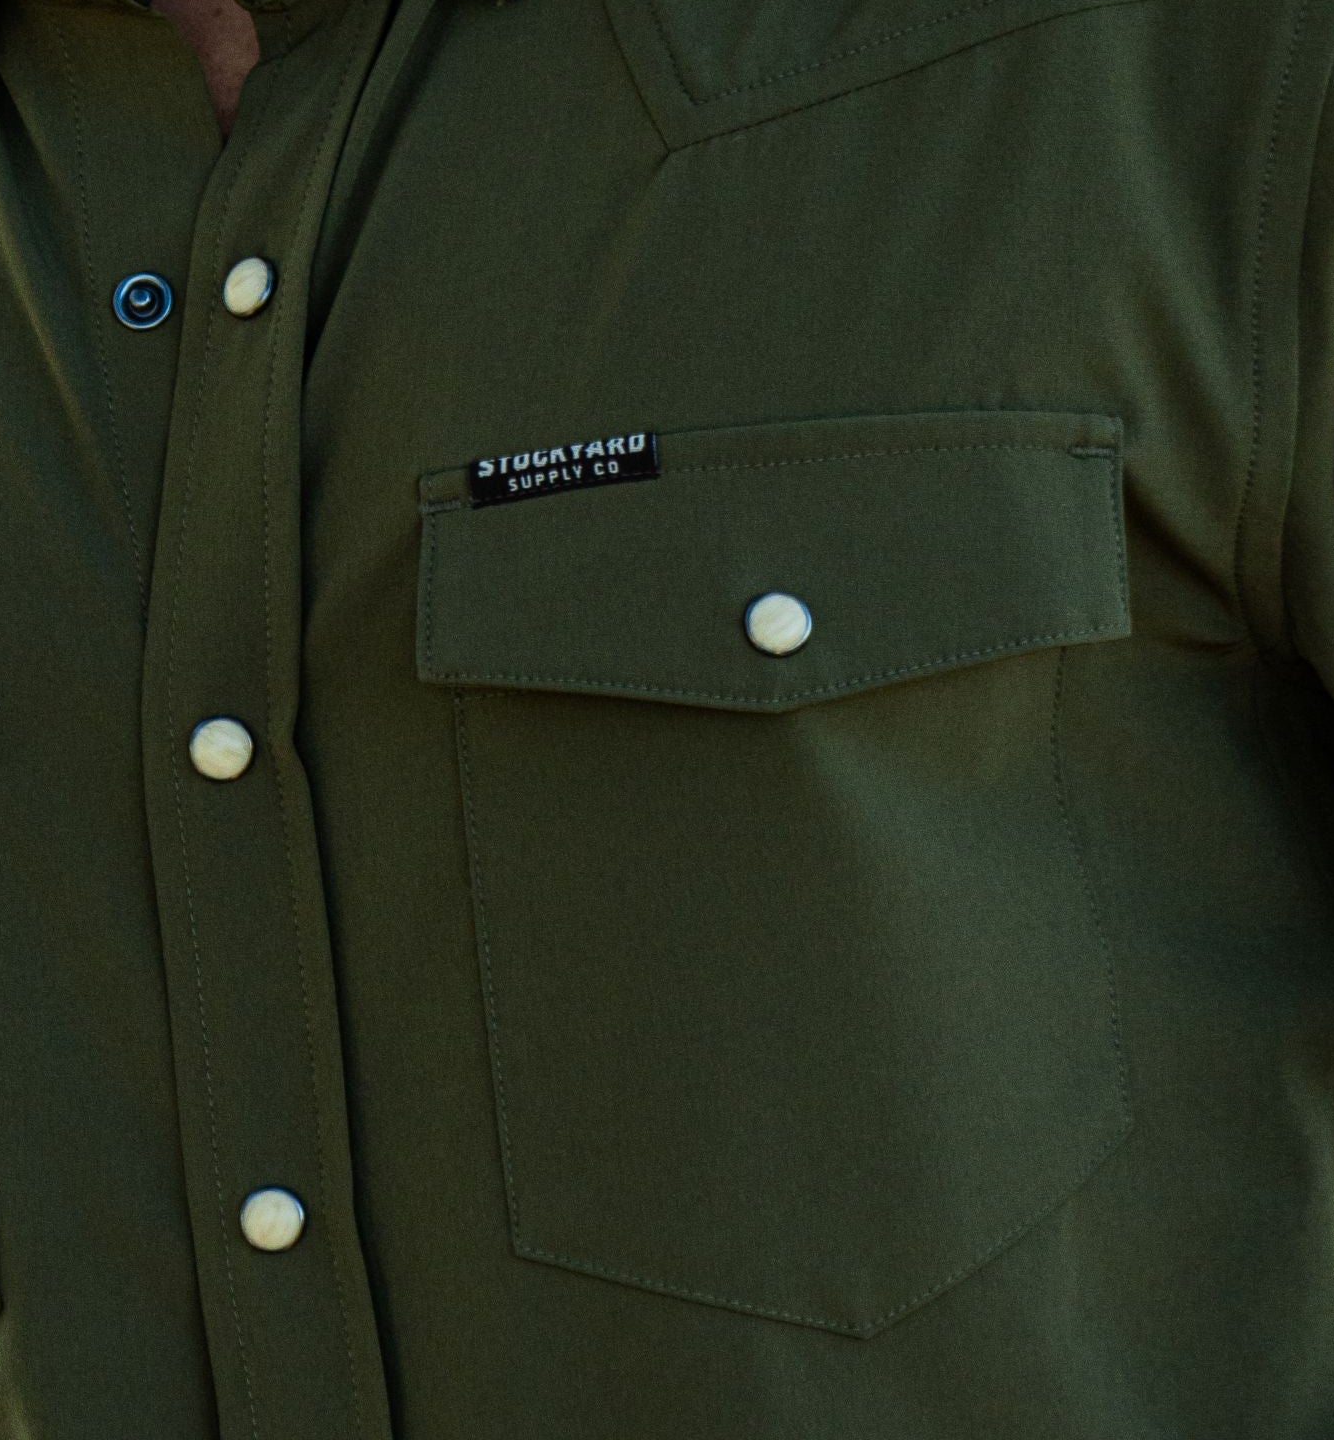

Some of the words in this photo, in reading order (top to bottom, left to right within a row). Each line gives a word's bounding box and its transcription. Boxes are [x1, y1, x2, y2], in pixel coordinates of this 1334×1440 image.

[478, 434, 646, 478] STOCKYARD
[508, 465, 582, 492] SUPPLY
[594, 461, 620, 476] CO
